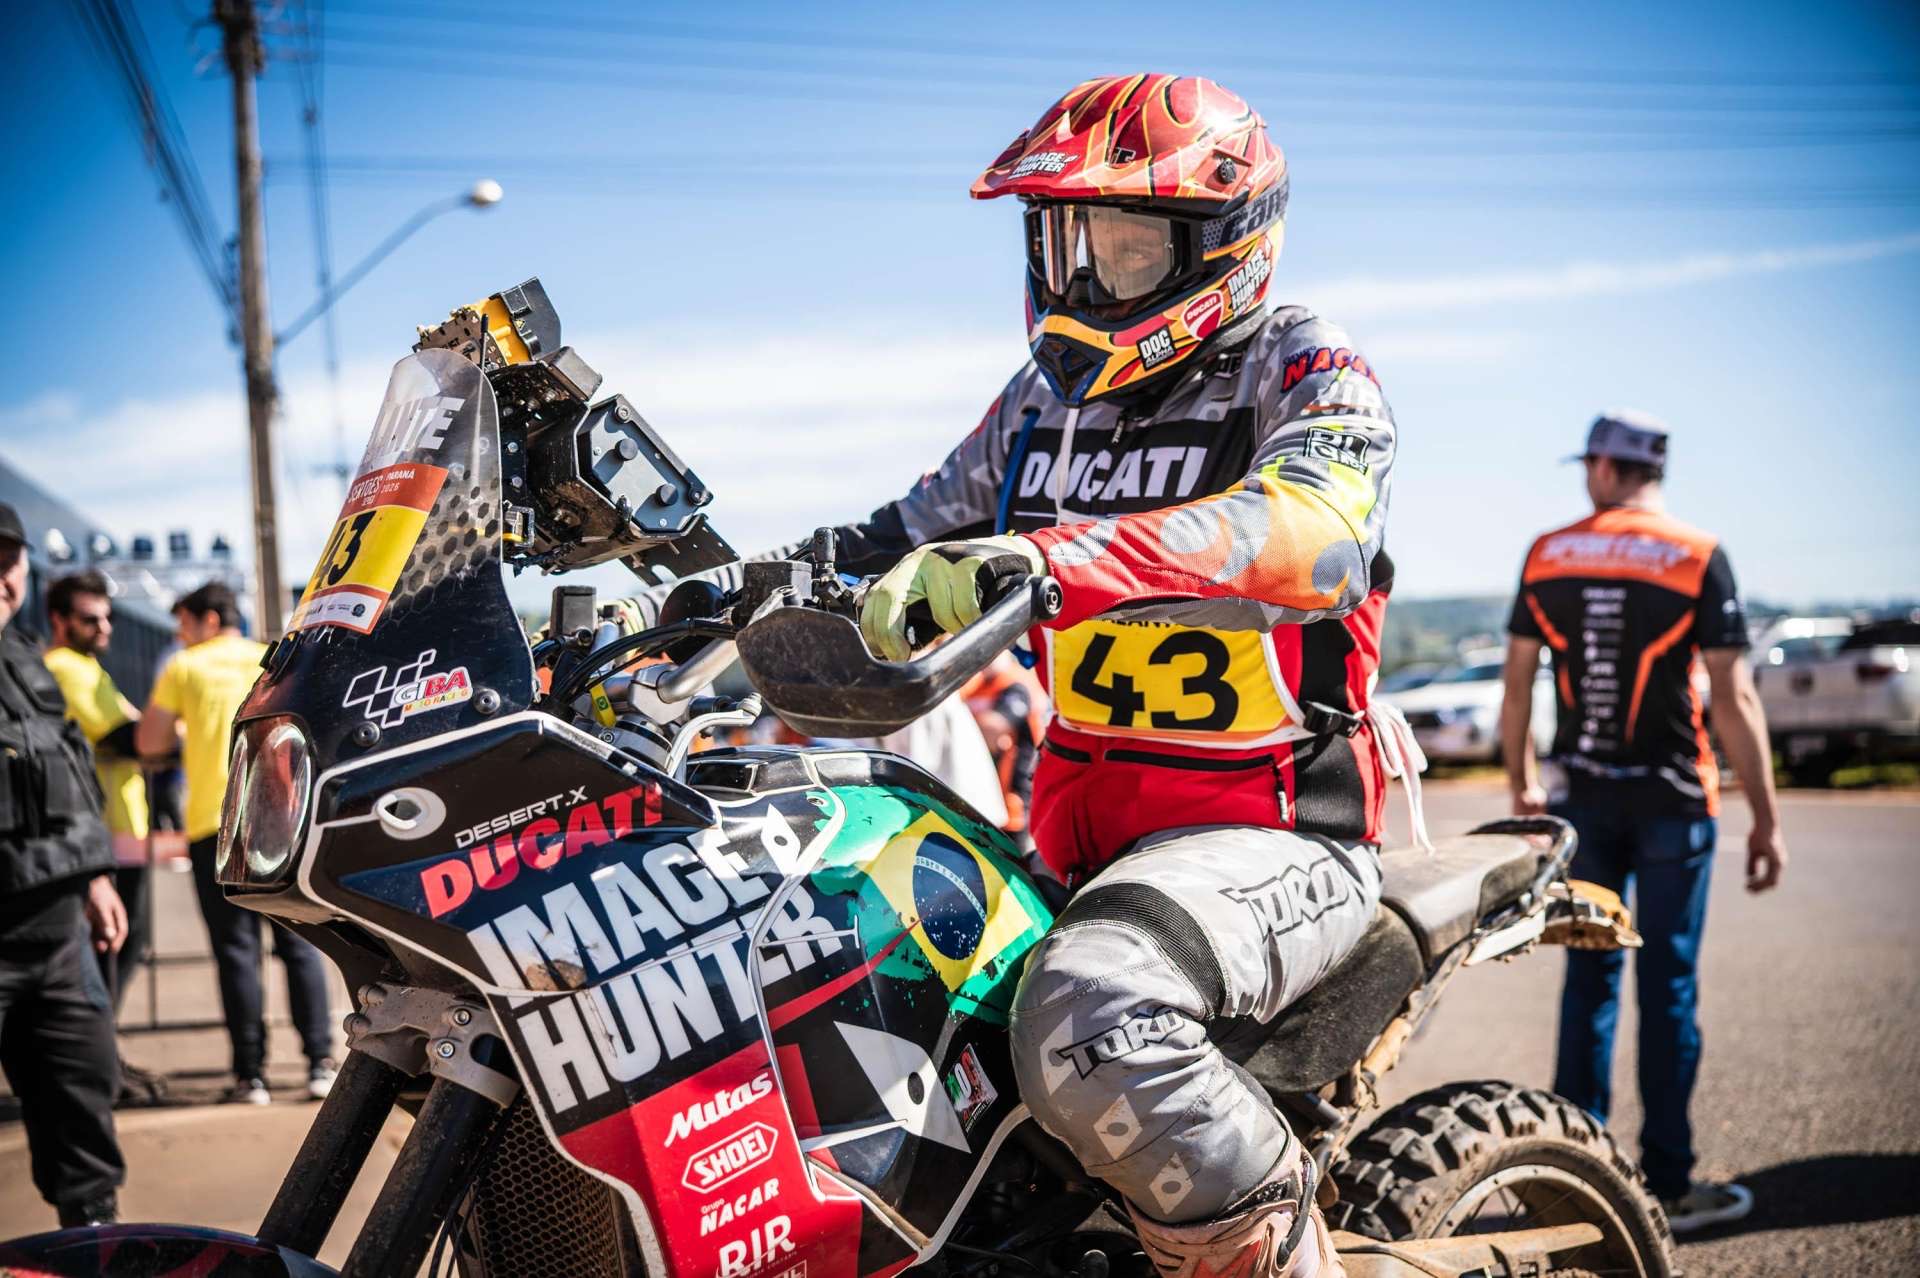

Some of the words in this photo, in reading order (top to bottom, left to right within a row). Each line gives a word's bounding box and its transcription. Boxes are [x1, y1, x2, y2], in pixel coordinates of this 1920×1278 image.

[1186, 295, 1218, 320] DUCATI
[1139, 329, 1171, 359] DOC
[1018, 446, 1208, 503] DUCATI
[312, 510, 377, 590] 43
[394, 669, 469, 705] GIBA
[1071, 630, 1239, 732] 43
[420, 781, 663, 919] DUCATI
[466, 828, 771, 1010] IMAGE
[516, 884, 843, 1115] HUNTER
[664, 1072, 774, 1148] Mitas
[693, 1128, 769, 1186] SHOEI
[700, 1197, 726, 1215] Grupo
[700, 1177, 780, 1238] NACAR
